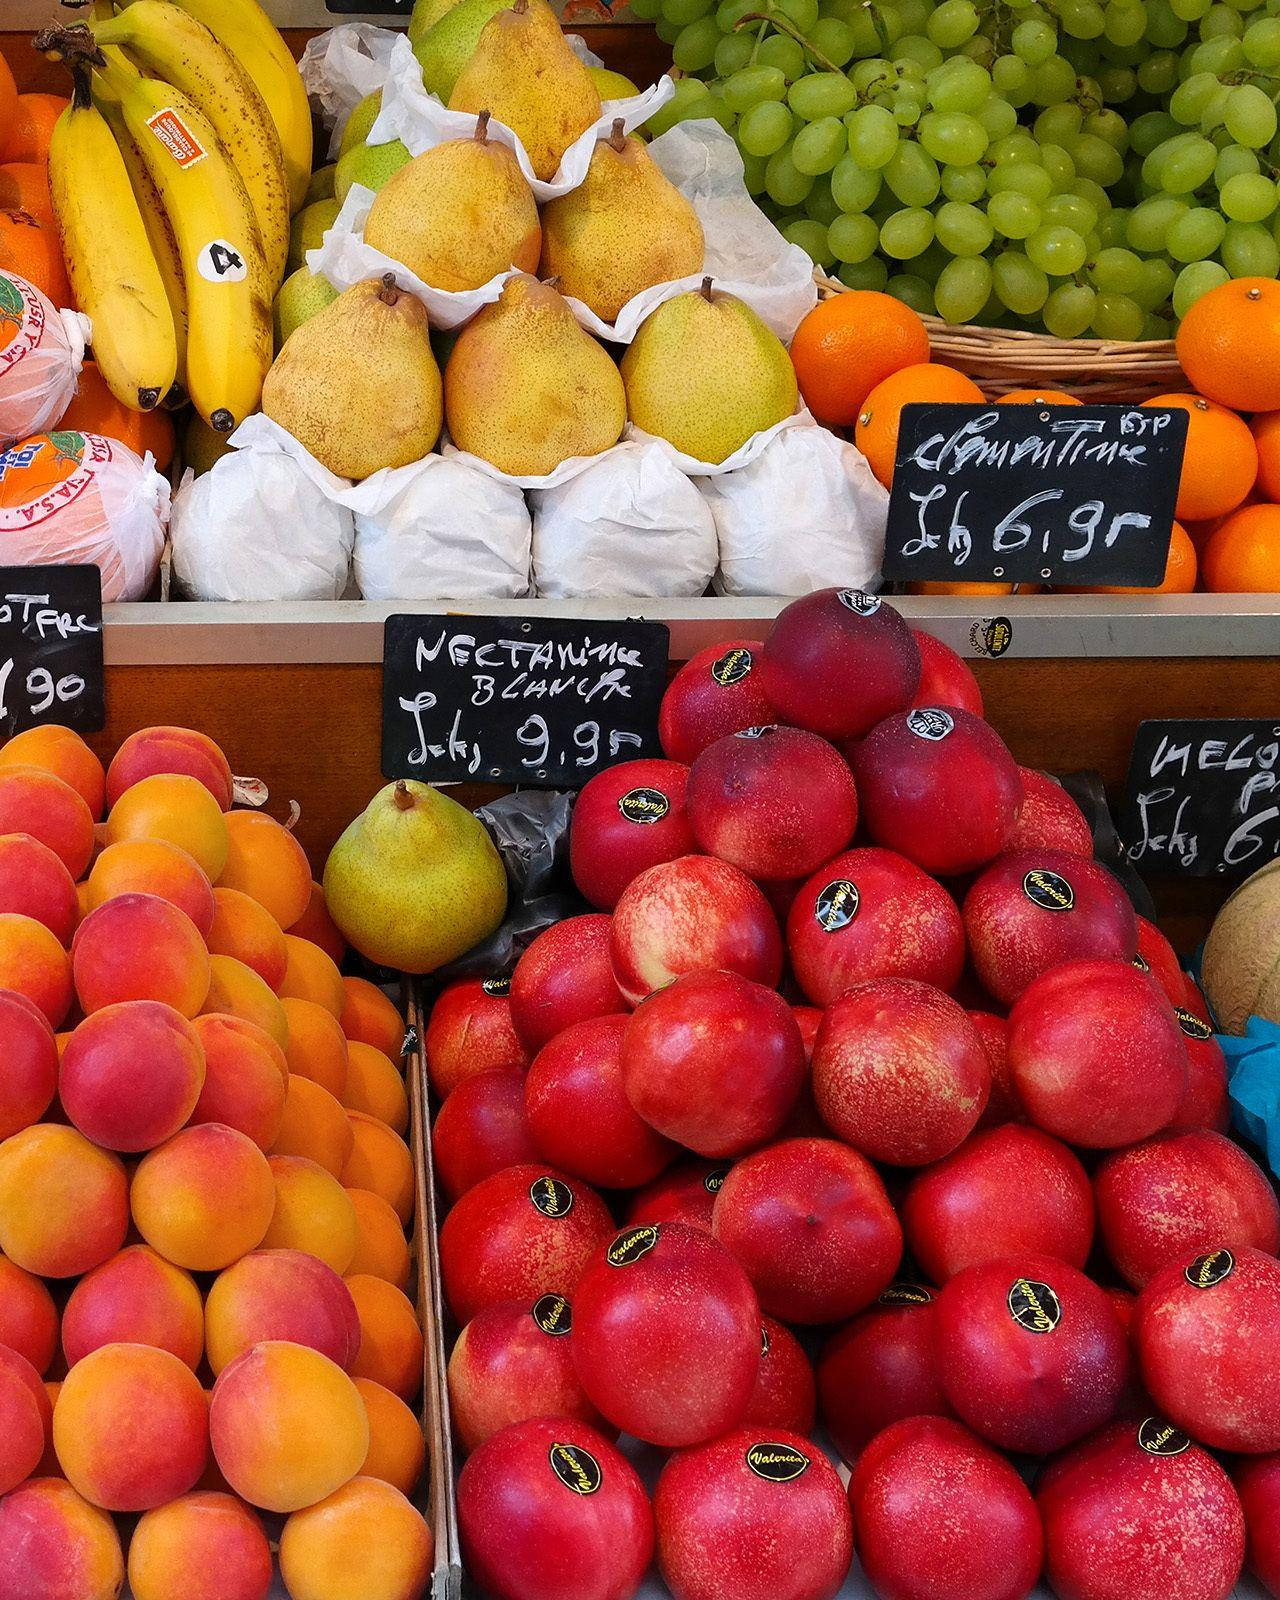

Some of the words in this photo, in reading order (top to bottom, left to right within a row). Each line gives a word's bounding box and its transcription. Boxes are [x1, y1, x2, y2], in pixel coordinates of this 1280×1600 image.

[153, 125, 186, 160] Banane
[209, 243, 242, 275] 4
[13, 442, 45, 468] TOI
